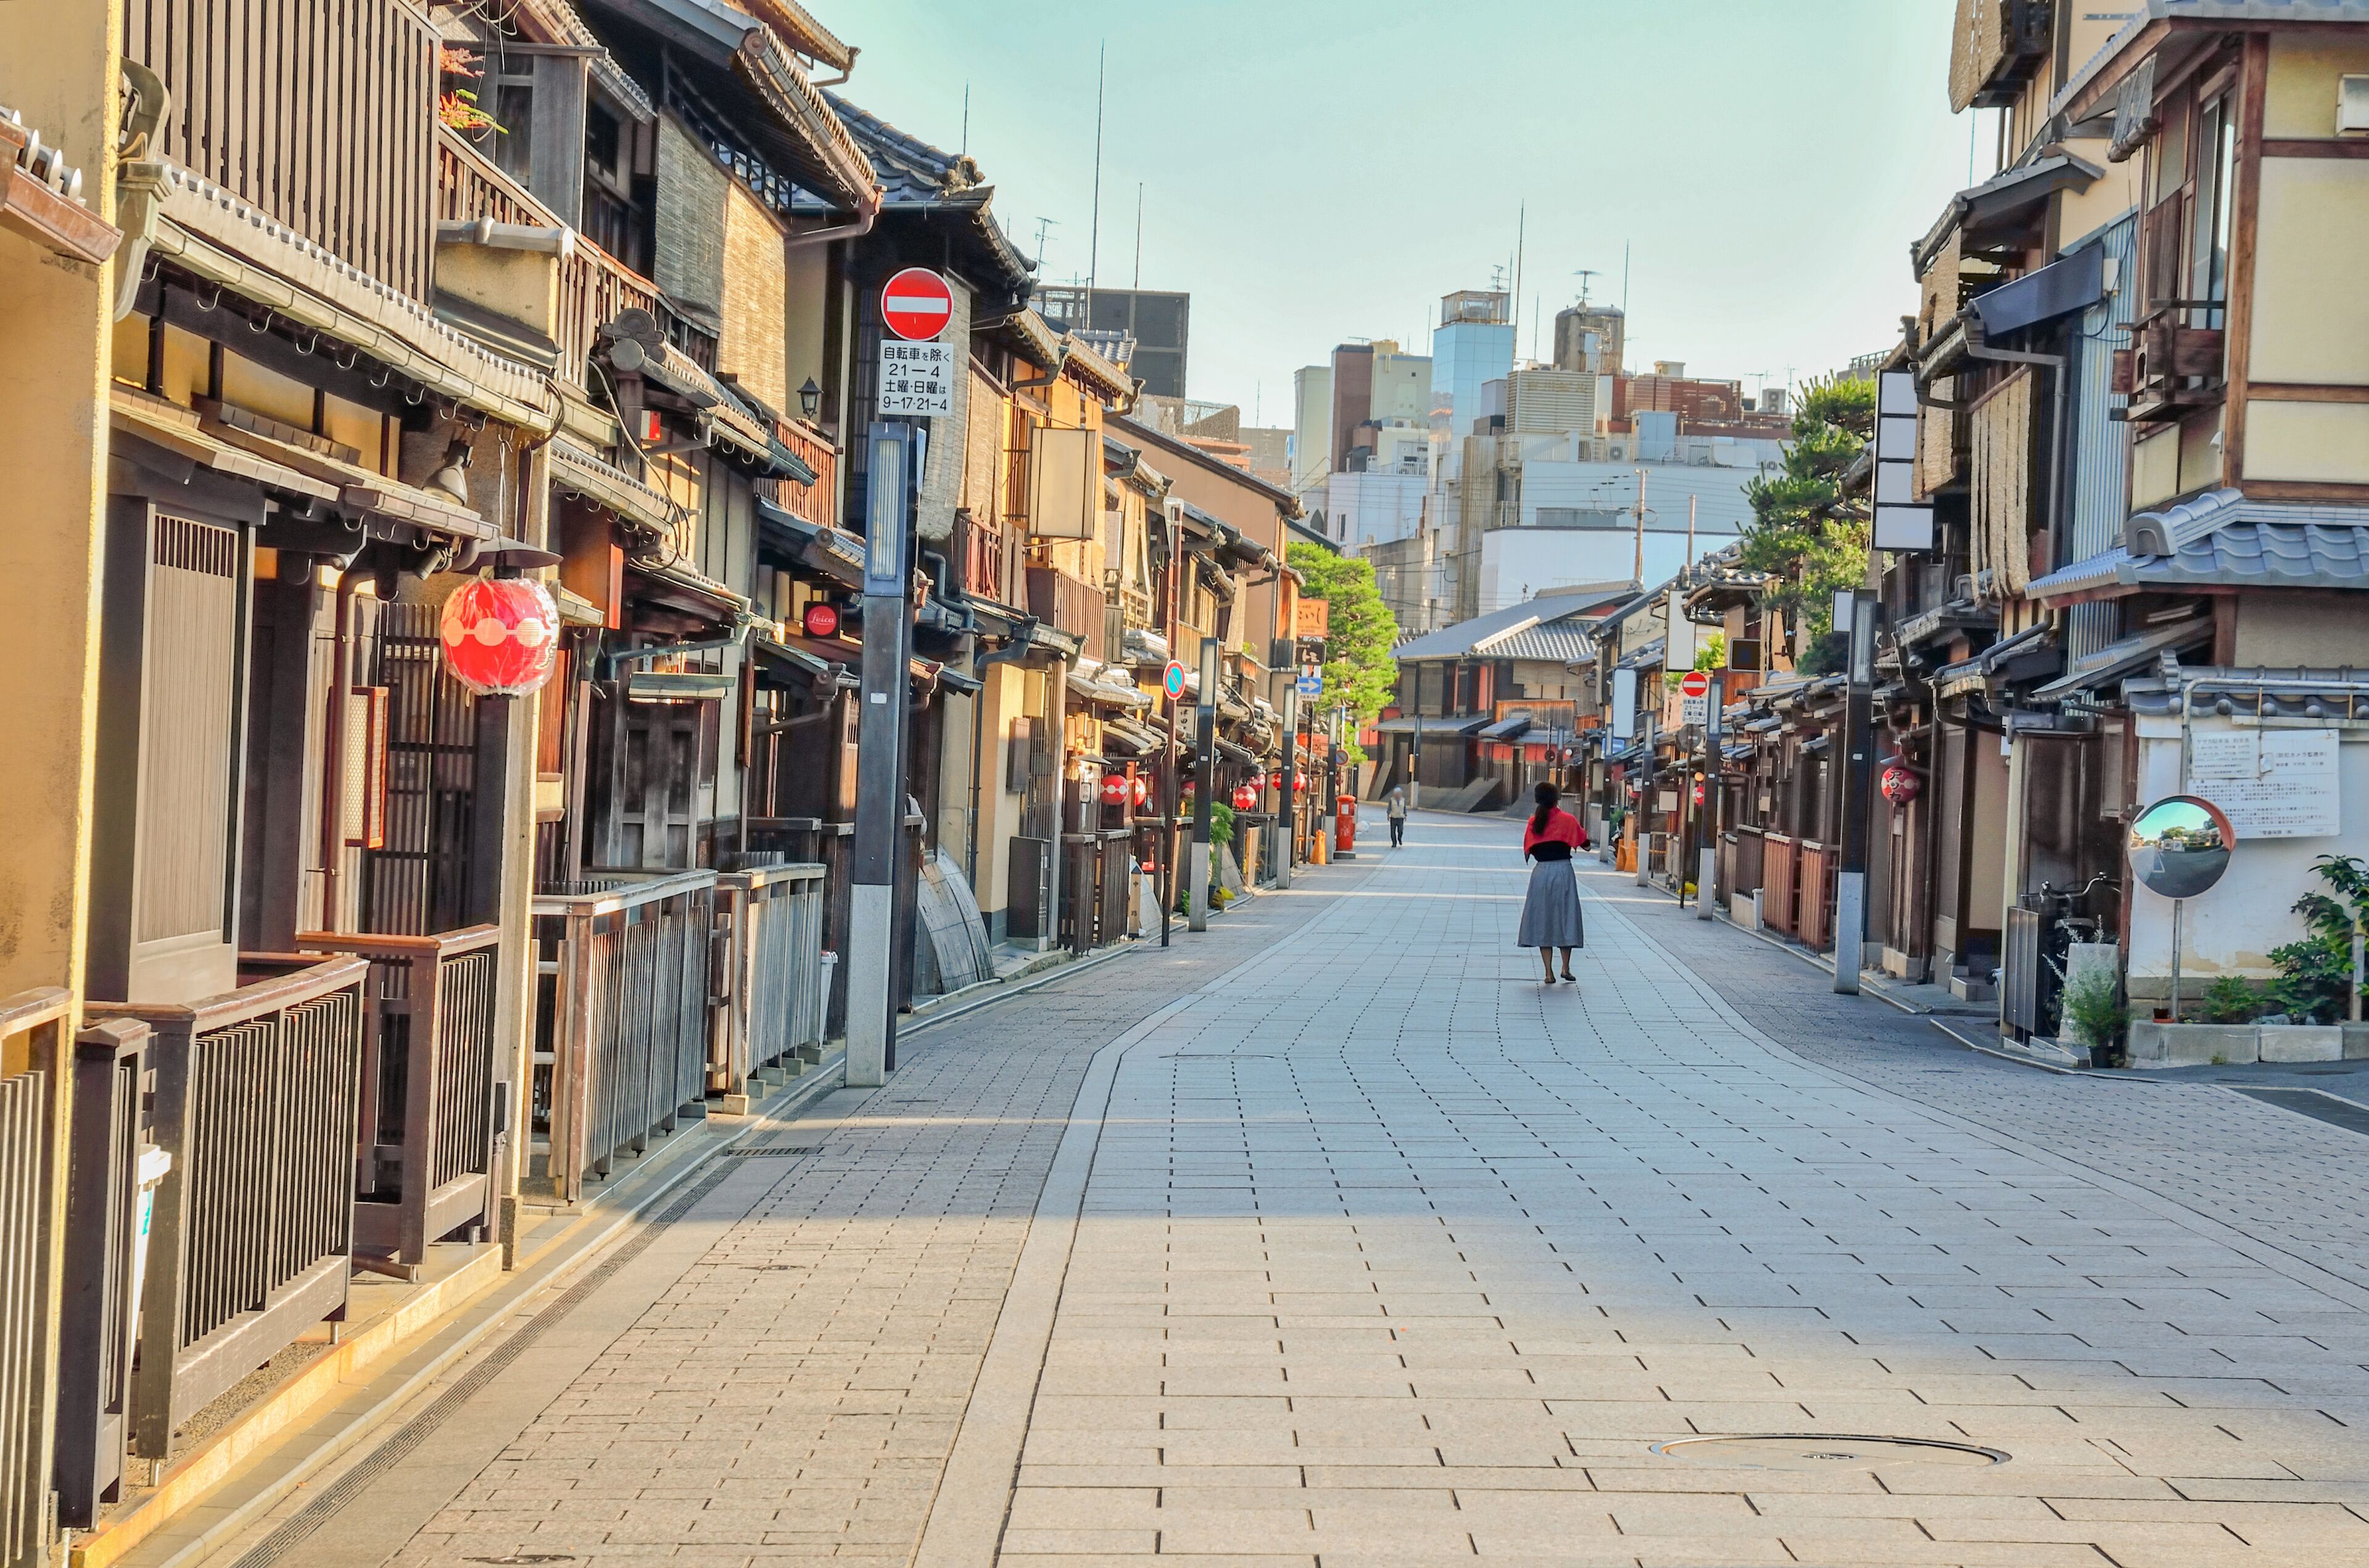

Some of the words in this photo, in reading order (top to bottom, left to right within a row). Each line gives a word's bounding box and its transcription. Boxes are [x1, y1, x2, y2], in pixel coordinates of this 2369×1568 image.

[884, 346, 950, 362] 自転車を除く
[810, 613, 834, 625] Leica
